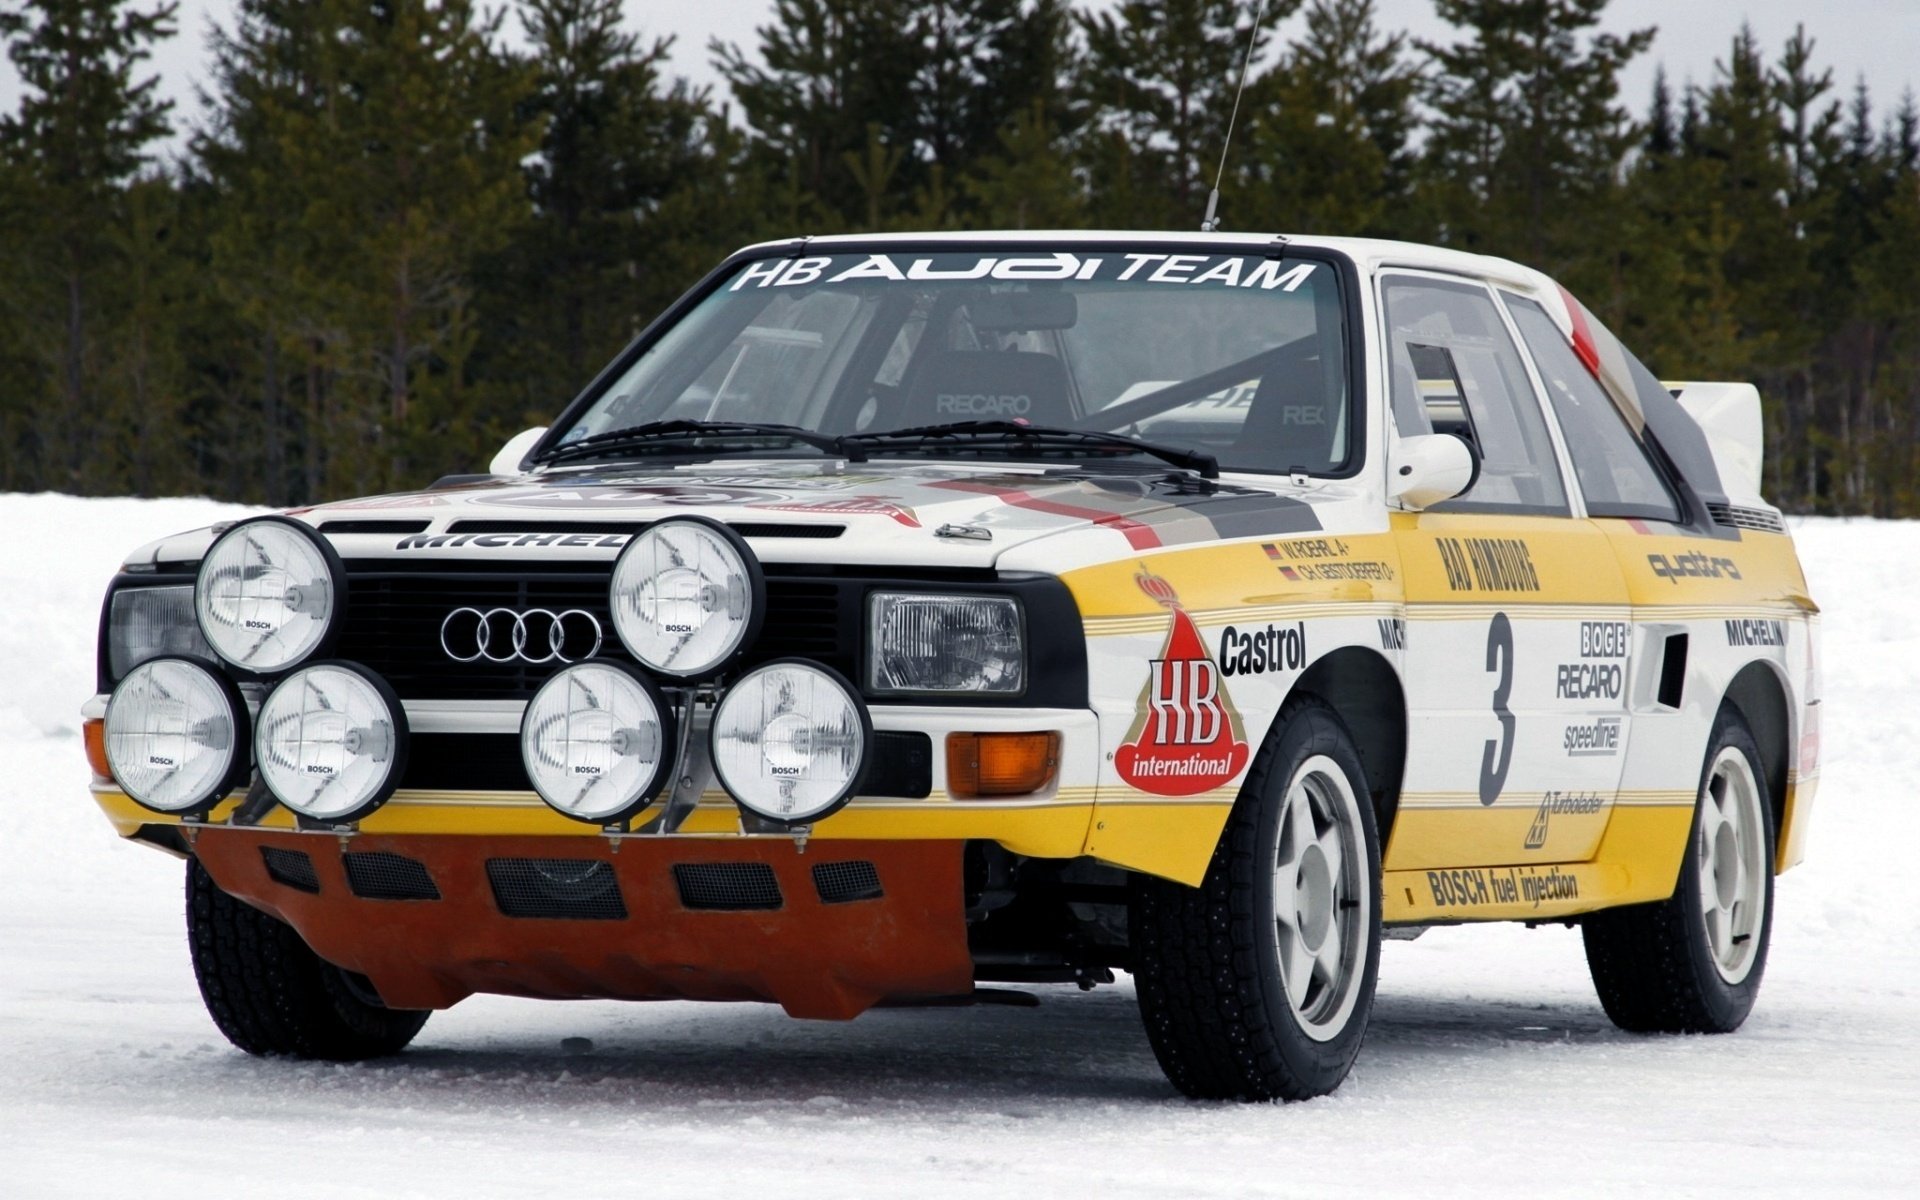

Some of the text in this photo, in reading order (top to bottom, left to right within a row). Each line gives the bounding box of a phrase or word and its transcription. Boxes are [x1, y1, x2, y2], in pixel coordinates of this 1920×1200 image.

[729, 257, 832, 292] HB
[1117, 253, 1317, 292] TEAM
[937, 394, 1031, 415] RECARO
[1435, 537, 1541, 592] BAD HOMBOURG
[1647, 550, 1742, 584] quattro
[245, 620, 271, 629] BOSCH
[665, 624, 692, 633] BOSCH
[1581, 622, 1625, 657] BOGE
[1725, 620, 1785, 646] MICHELIN
[1220, 621, 1306, 677] Castrol
[1556, 664, 1622, 699] RECARO
[1149, 659, 1222, 745] HB
[1479, 611, 1516, 807] 3
[1564, 718, 1618, 757] speedline
[150, 756, 174, 766] BOSCH
[307, 765, 333, 774] BOSCH
[575, 765, 601, 774] BOSCH
[771, 766, 799, 776] BOSCH
[1132, 752, 1232, 777] international
[1550, 791, 1605, 814] Turbolader
[1427, 866, 1578, 909] BOSCH fuel injection
